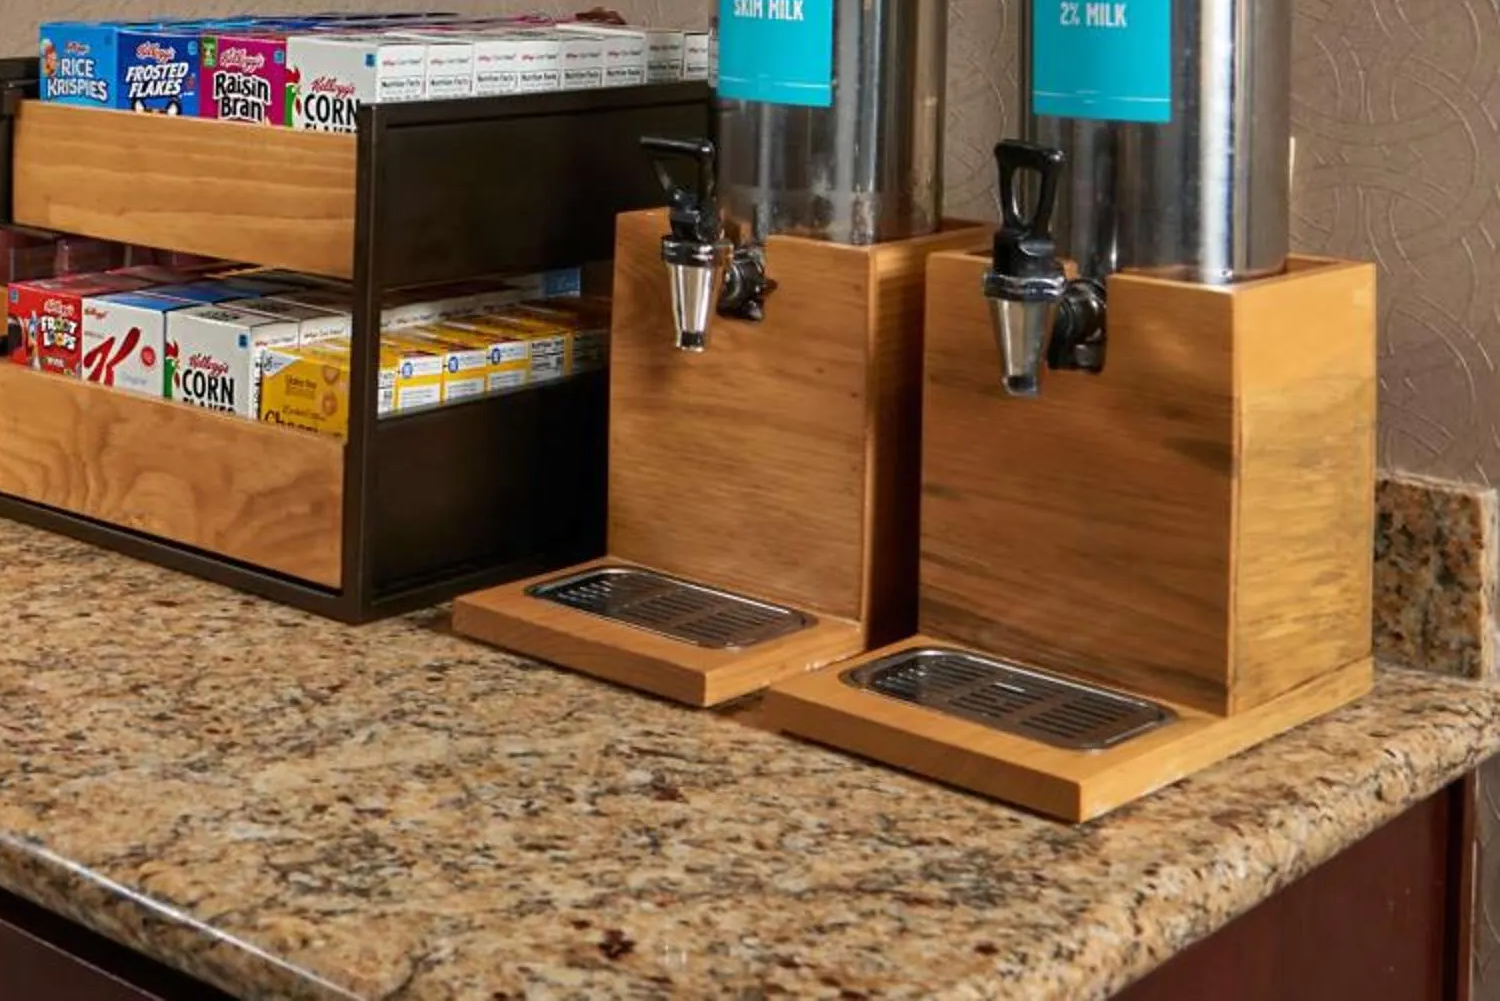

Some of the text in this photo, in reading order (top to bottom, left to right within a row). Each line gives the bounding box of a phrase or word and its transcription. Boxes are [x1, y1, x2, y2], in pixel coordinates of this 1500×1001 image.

[1060, 0, 1127, 28] 2% MILK
[61, 58, 95, 78] RICE
[126, 62, 190, 83] FROSTED
[47, 78, 108, 101] KRISPIES
[129, 79, 183, 98] FLAKES
[215, 72, 270, 102] Raisin
[220, 97, 263, 121] Bran
[304, 93, 360, 126] CORN
[40, 315, 78, 334] FROOT
[43, 331, 77, 350] LOOPS
[182, 368, 235, 405] CORN
